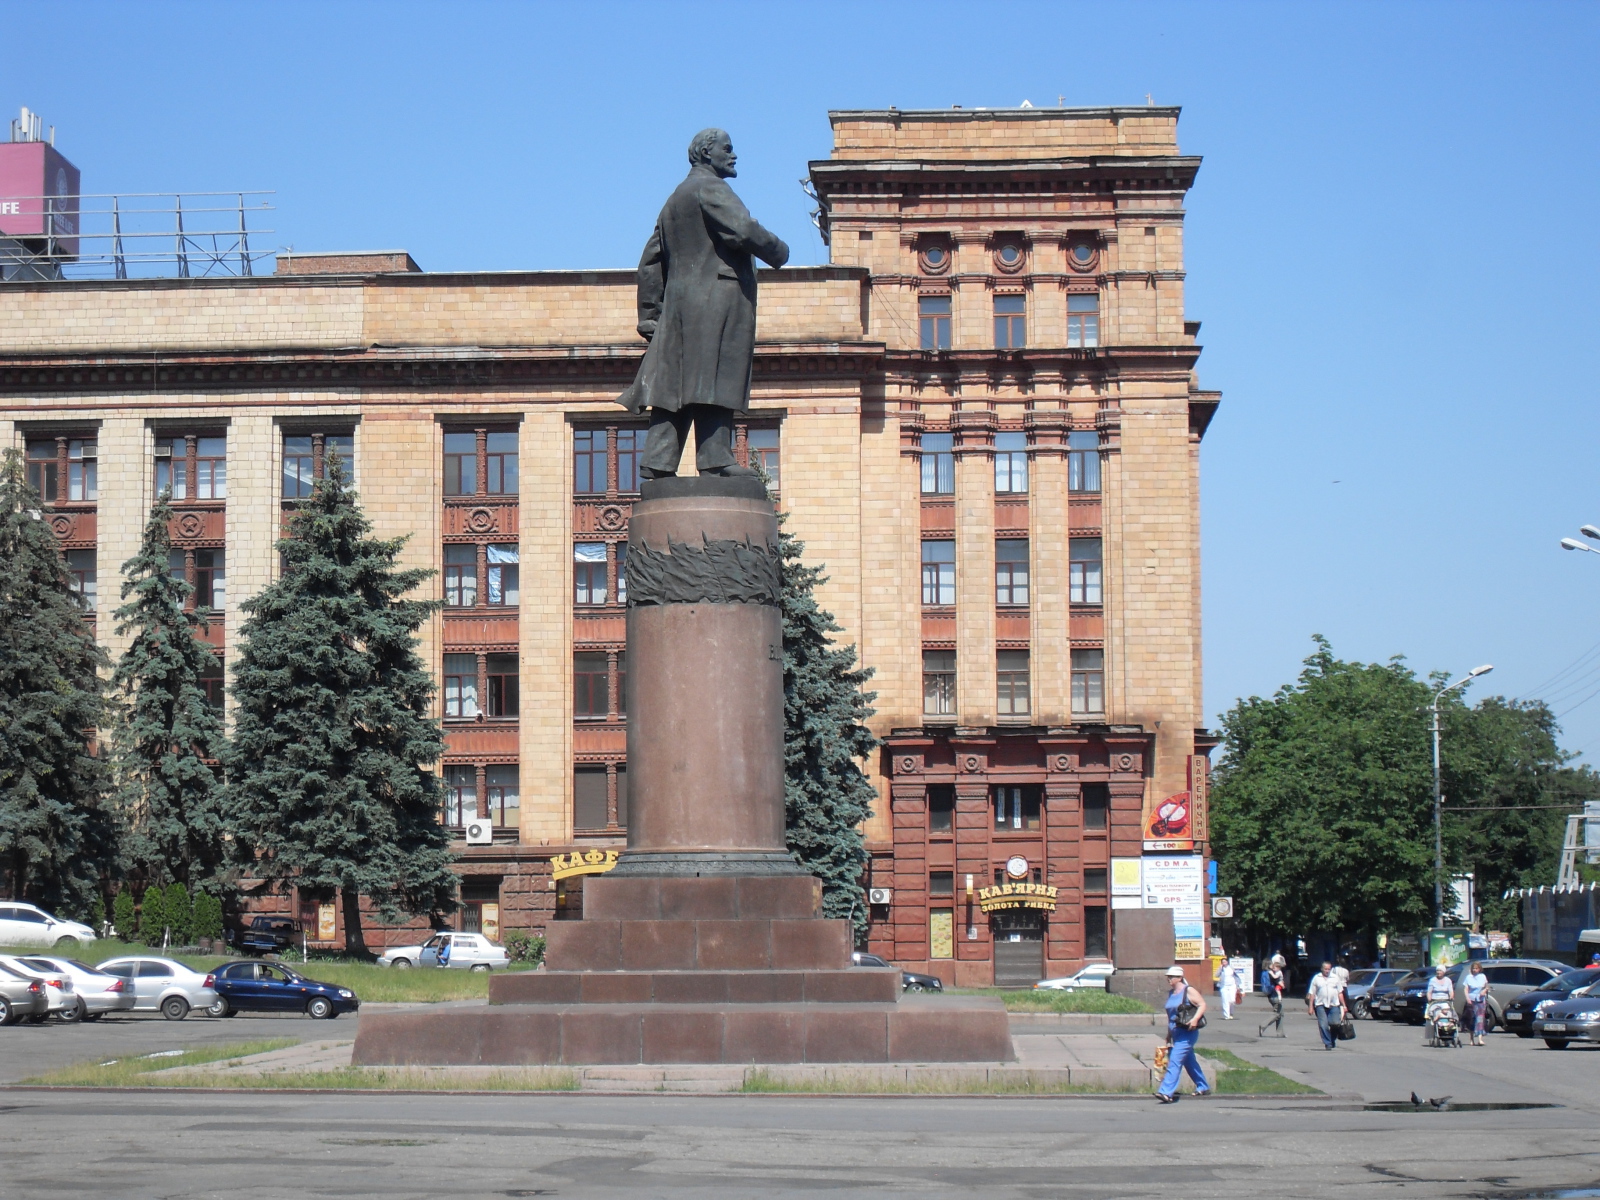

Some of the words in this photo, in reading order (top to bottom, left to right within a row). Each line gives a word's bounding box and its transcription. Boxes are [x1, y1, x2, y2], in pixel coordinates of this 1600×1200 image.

[1195, 759, 1203, 836] ВАРЕНИЧНА
[550, 849, 619, 872] КАФЕ
[979, 883, 1058, 900] КАВ'ЯРНЯ
[981, 901, 1020, 912] ЗОЛОТА
